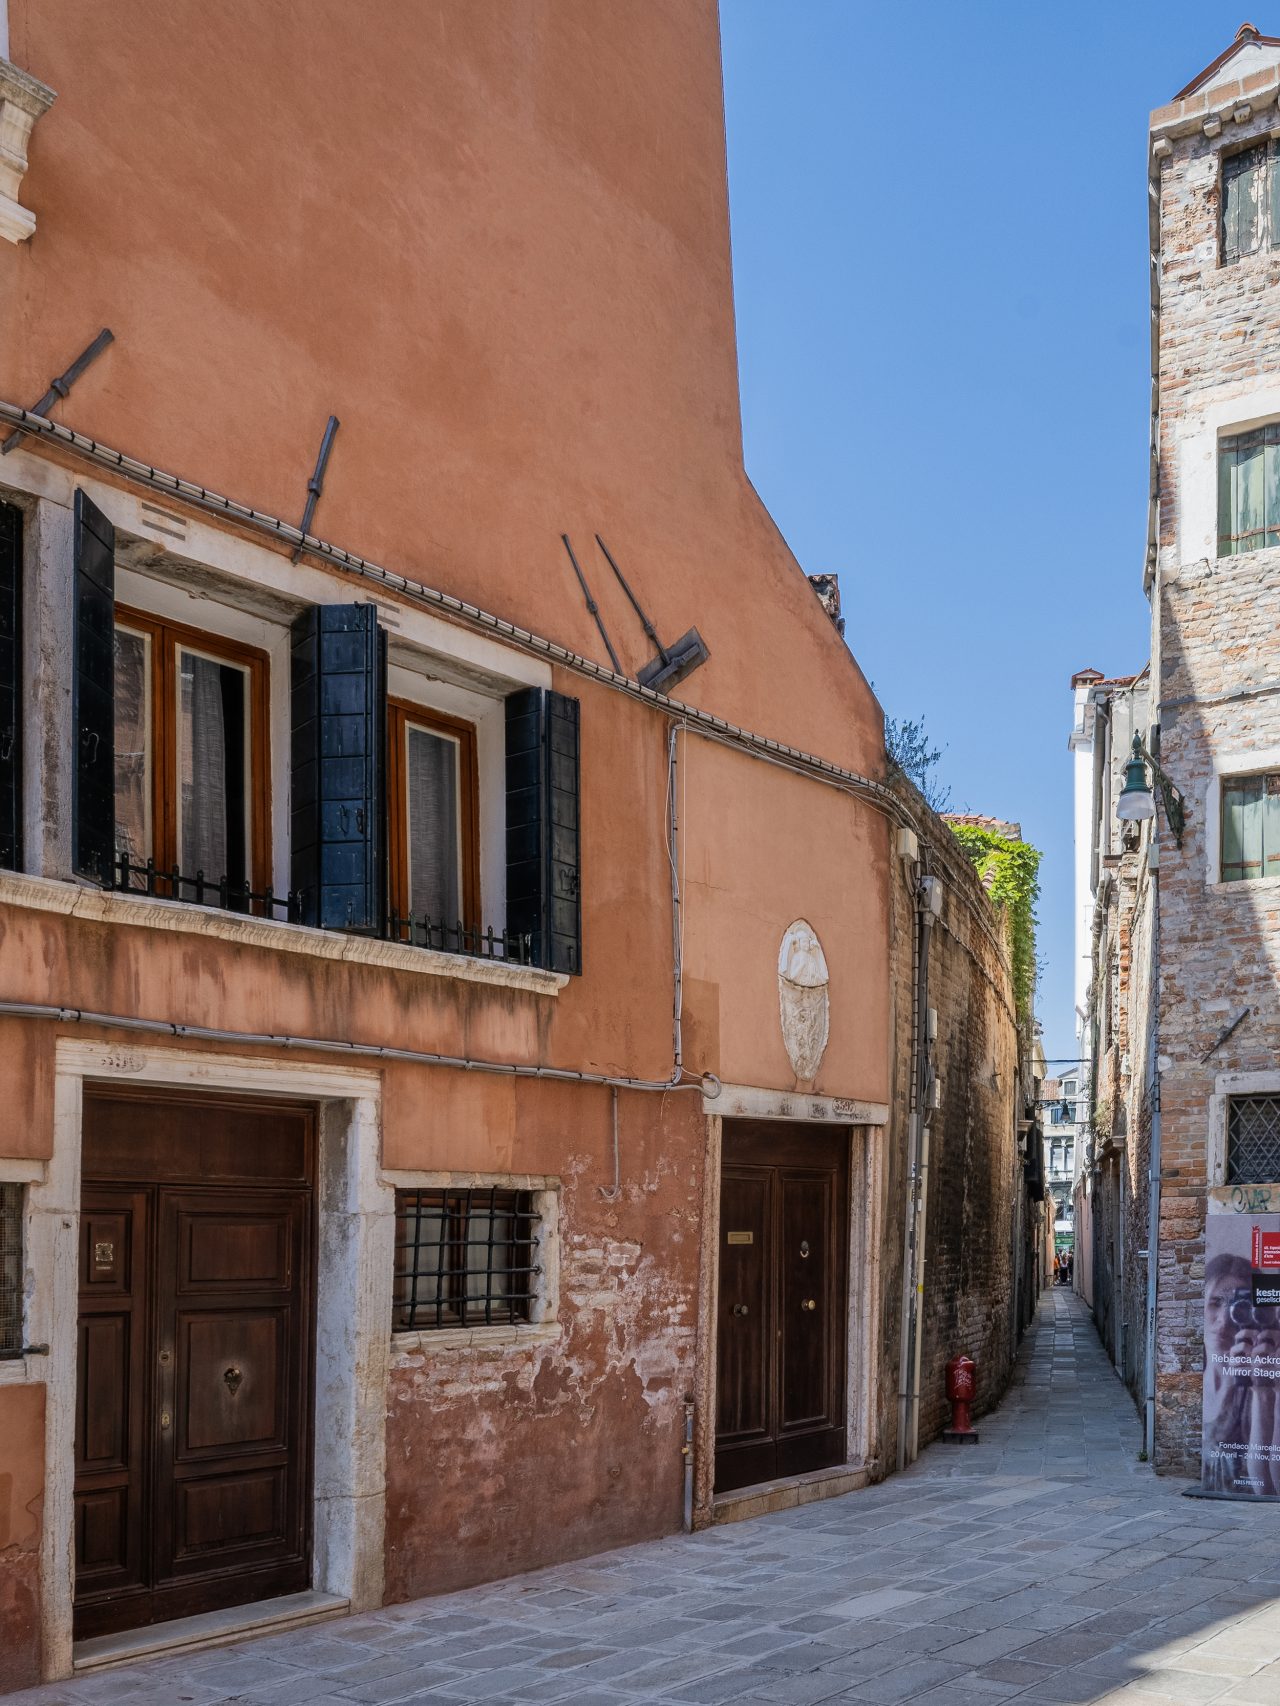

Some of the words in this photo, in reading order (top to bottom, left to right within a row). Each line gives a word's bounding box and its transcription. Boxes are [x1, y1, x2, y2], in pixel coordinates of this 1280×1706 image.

[1211, 1353, 1252, 1364] Rebecca
[1222, 1367, 1251, 1377] Mirror
[1253, 1368, 1280, 1379] Stage
[1219, 1441, 1249, 1450] Fondaco
[1250, 1443, 1280, 1452] Marcello
[1220, 1451, 1237, 1460] April
